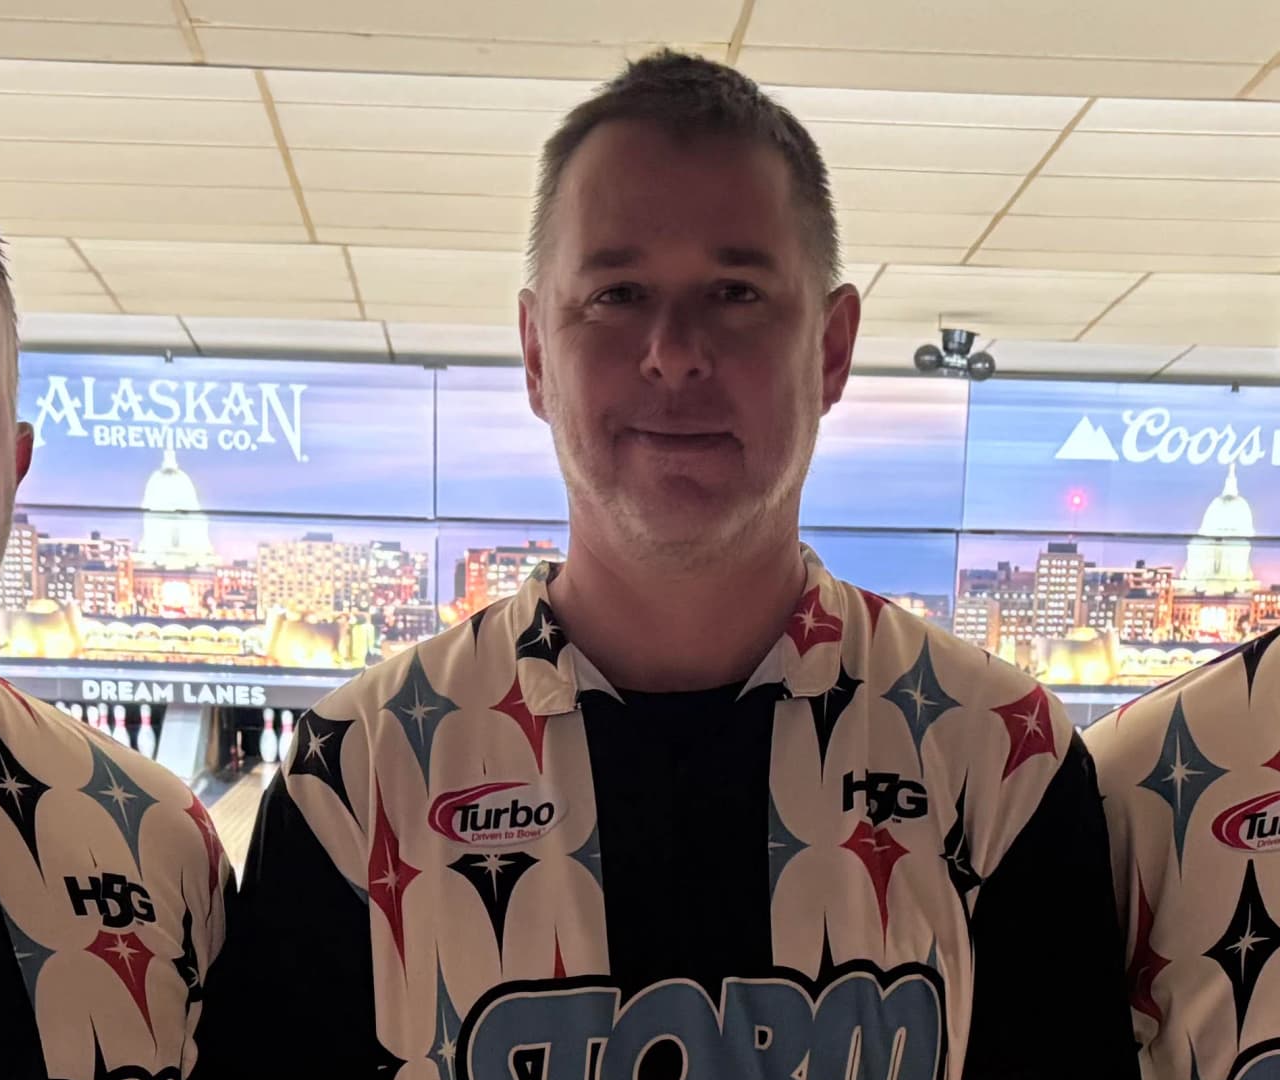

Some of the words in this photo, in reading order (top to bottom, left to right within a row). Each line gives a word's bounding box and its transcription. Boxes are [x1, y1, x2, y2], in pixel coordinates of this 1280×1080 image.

[32, 375, 308, 462] ALASKAN
[93, 425, 208, 450] BREWING
[218, 428, 258, 451] CO.
[1122, 407, 1265, 466] Coors
[82, 680, 174, 702] DREAM
[183, 684, 266, 705] LANES
[455, 799, 555, 832] Turbo
